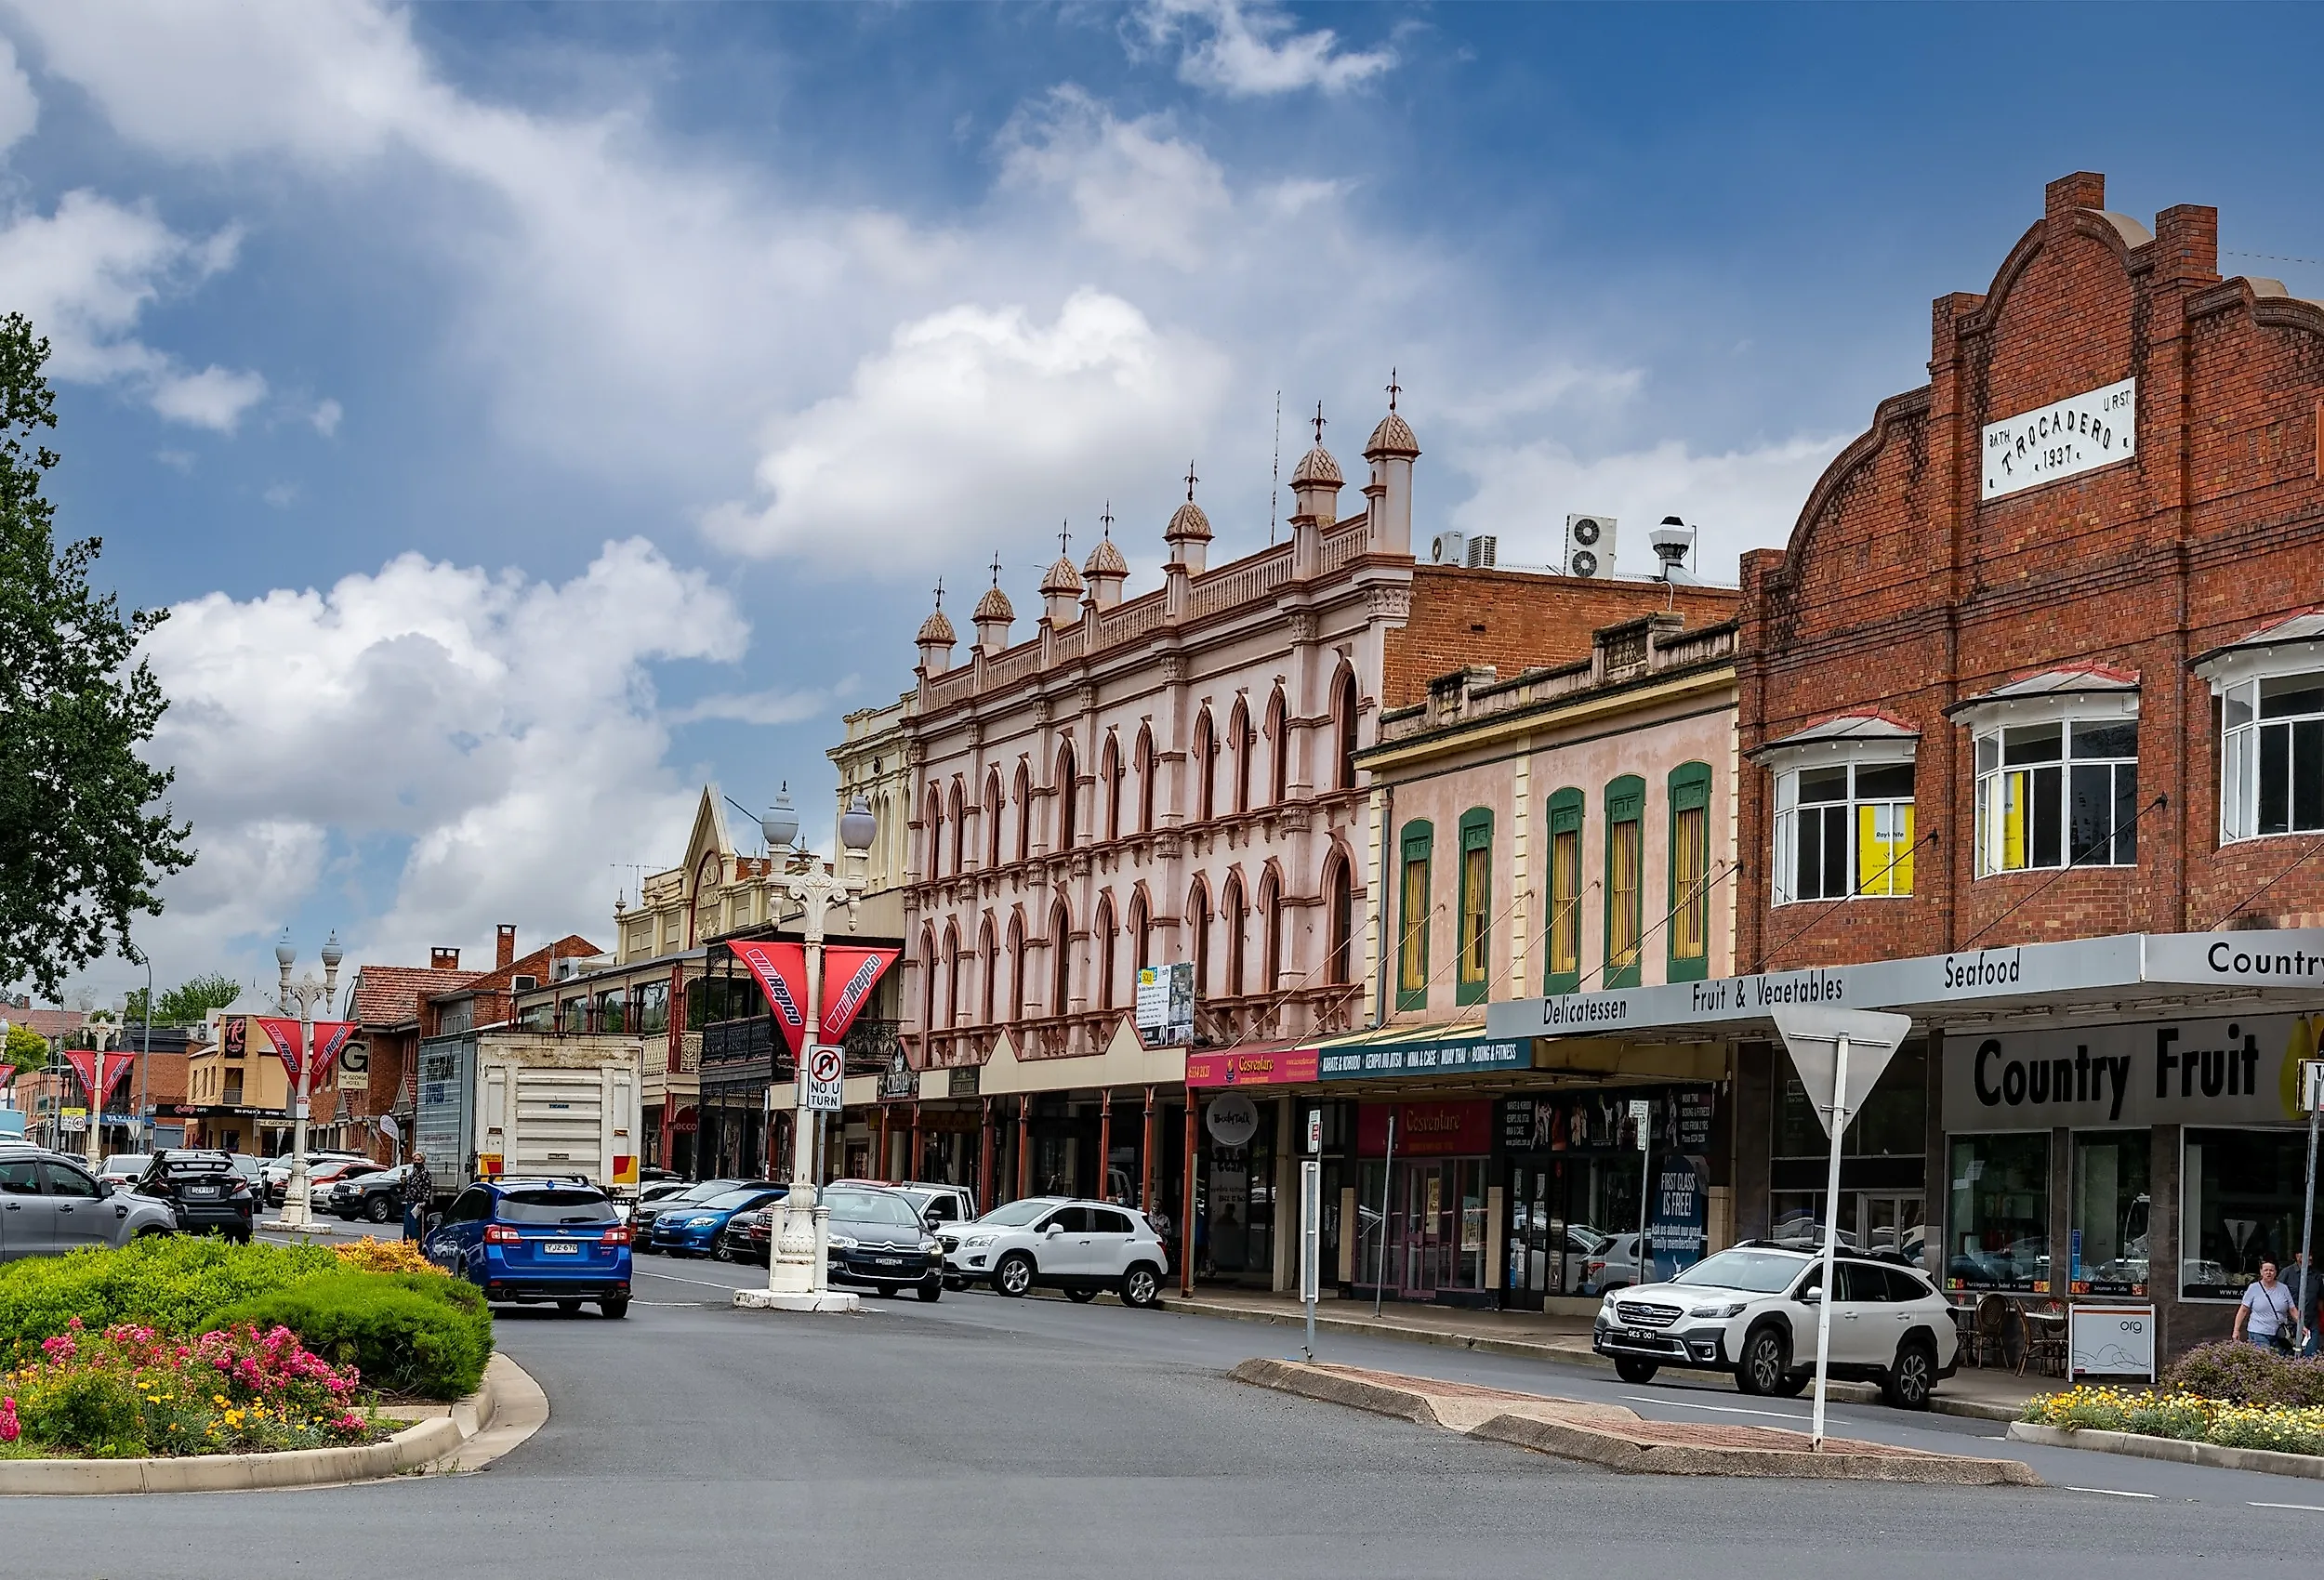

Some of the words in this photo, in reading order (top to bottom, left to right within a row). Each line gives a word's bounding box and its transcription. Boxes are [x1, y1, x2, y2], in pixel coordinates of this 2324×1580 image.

[1988, 428, 2012, 448] BATH
[2103, 389, 2132, 412] URST
[2000, 410, 2112, 476] TROCADERO
[2043, 443, 2072, 469] 1937
[1944, 947, 2021, 990] Seafood
[2207, 941, 2324, 985] Countr
[847, 955, 882, 1002] Repco
[767, 975, 803, 1026] Repco
[1542, 995, 1628, 1025] Delicatessen
[1692, 981, 1727, 1012] Fruit
[1736, 979, 1746, 1008] &
[325, 1026, 348, 1058] Repco
[280, 1042, 299, 1072] Repco
[339, 1042, 368, 1073] G
[1322, 1057, 1339, 1072] KARATE
[1339, 1057, 1343, 1071] &
[1343, 1055, 1361, 1070] KOBUDO
[1366, 1053, 1381, 1069] KEMPO
[1406, 1052, 1419, 1067] MMA
[1419, 1051, 1424, 1066] &
[1424, 1050, 1437, 1066] CAGE
[1441, 1048, 1455, 1065] MUAY
[1455, 1047, 1466, 1064] THAI
[1472, 1045, 1489, 1062] BOXING
[1489, 1045, 1495, 1061] &
[1495, 1043, 1517, 1061] FITNESS
[1974, 1038, 2131, 1121] Country
[2155, 1023, 2259, 1099] Fruit
[811, 1082, 827, 1093] NO
[832, 1083, 840, 1093] U
[811, 1095, 838, 1107] TURN
[1406, 1110, 1460, 1132] Cosventure
[1639, 1116, 1646, 1126] 1P
[1660, 1172, 1677, 1192] FIRST
[1677, 1172, 1696, 1192] CLASS
[1662, 1192, 1671, 1217] IS
[1671, 1192, 1693, 1218] FREE!
[1651, 1222, 1660, 1235] Ask
[1660, 1224, 1666, 1235] us
[1666, 1223, 1680, 1236] about
[1680, 1226, 1688, 1236] our
[1688, 1225, 1702, 1239] great
[1651, 1237, 1667, 1252] family
[1667, 1237, 1701, 1253] memberships!
[2119, 1321, 2143, 1335] org
